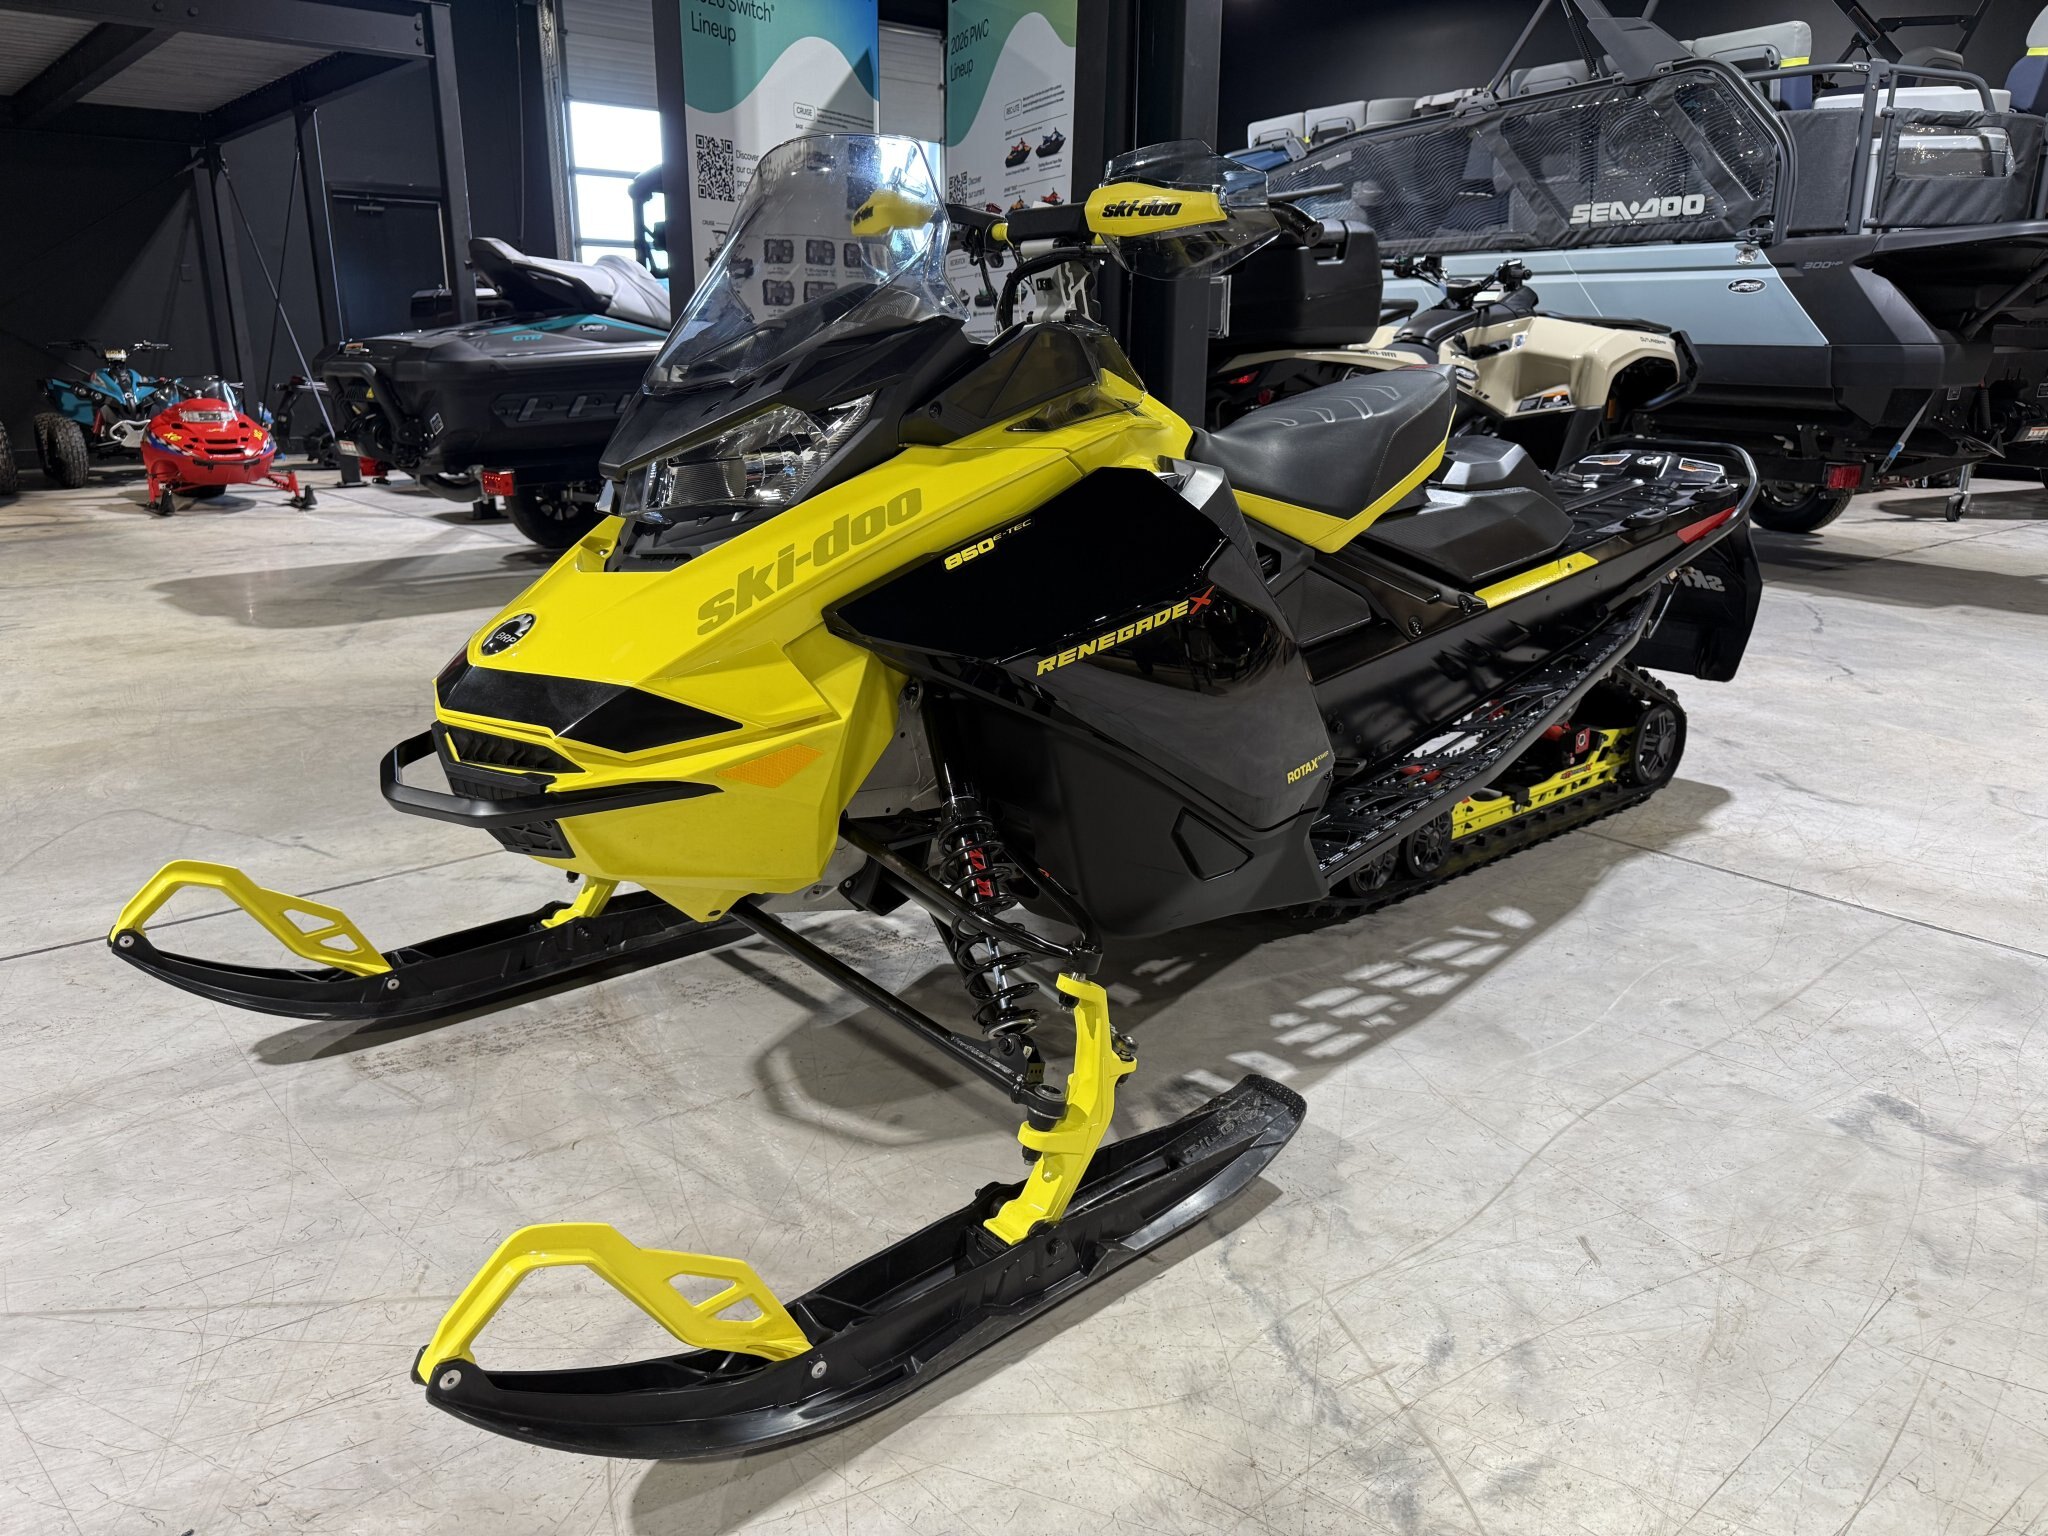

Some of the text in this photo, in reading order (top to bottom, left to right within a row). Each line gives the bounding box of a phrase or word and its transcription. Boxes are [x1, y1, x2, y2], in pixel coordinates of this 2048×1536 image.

[691, 10, 737, 46] Lineup
[951, 18, 989, 56] 2026 PWC
[950, 59, 974, 82] Lineup
[796, 106, 813, 117] CRUISE
[736, 149, 760, 162] Discover
[1102, 199, 1182, 217] ski-doo
[944, 518, 1032, 571] 850 E-TEC
[697, 487, 922, 636] ski-doo
[495, 631, 518, 643] BRP
[1036, 585, 1215, 676] RENEGADE X
[1286, 757, 1319, 785] ROTAX
